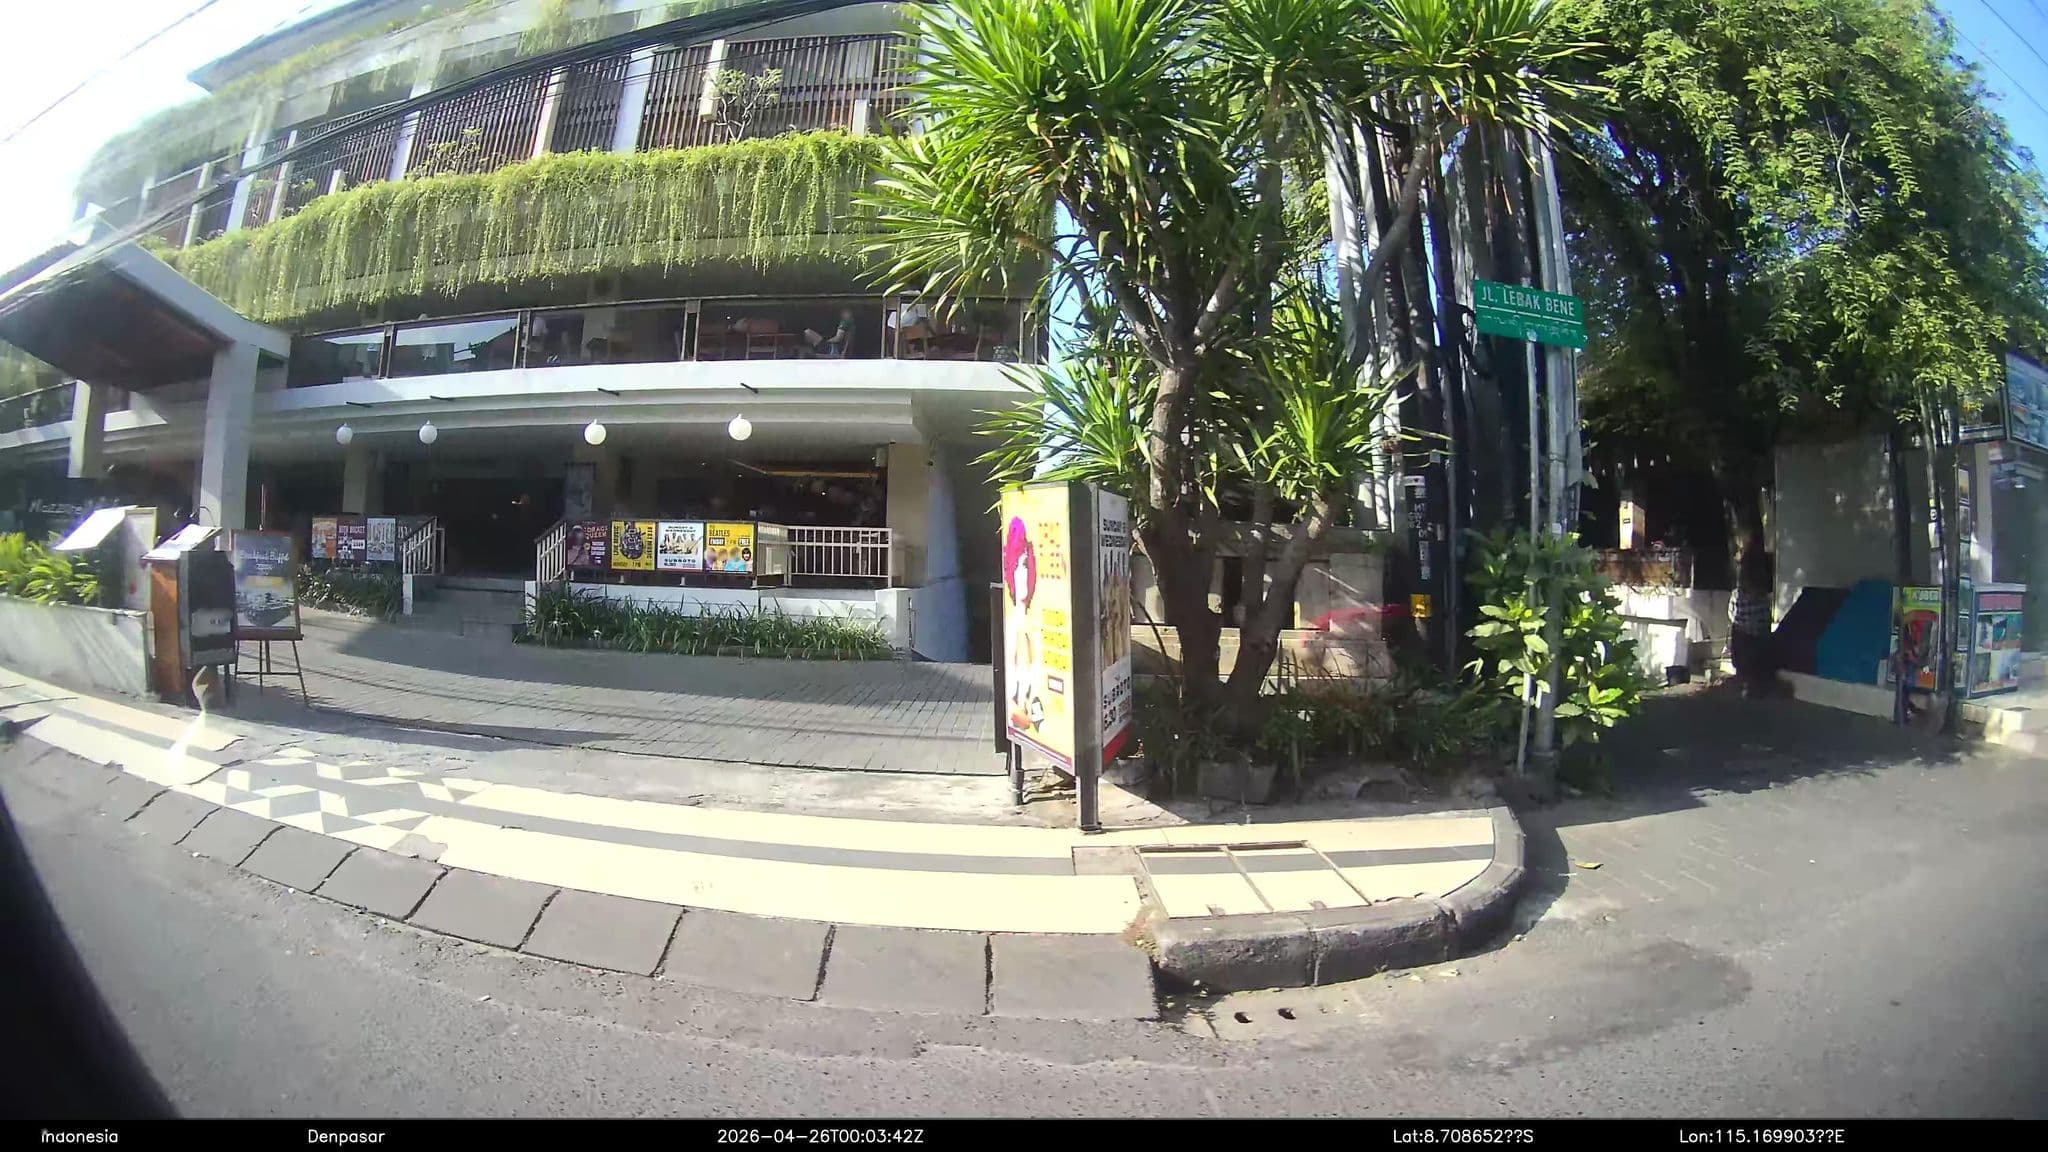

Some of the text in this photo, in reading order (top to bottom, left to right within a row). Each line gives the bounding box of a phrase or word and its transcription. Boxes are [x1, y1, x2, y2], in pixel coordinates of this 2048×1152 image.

[1482, 286, 1575, 317] JL. LEBAK BENE
